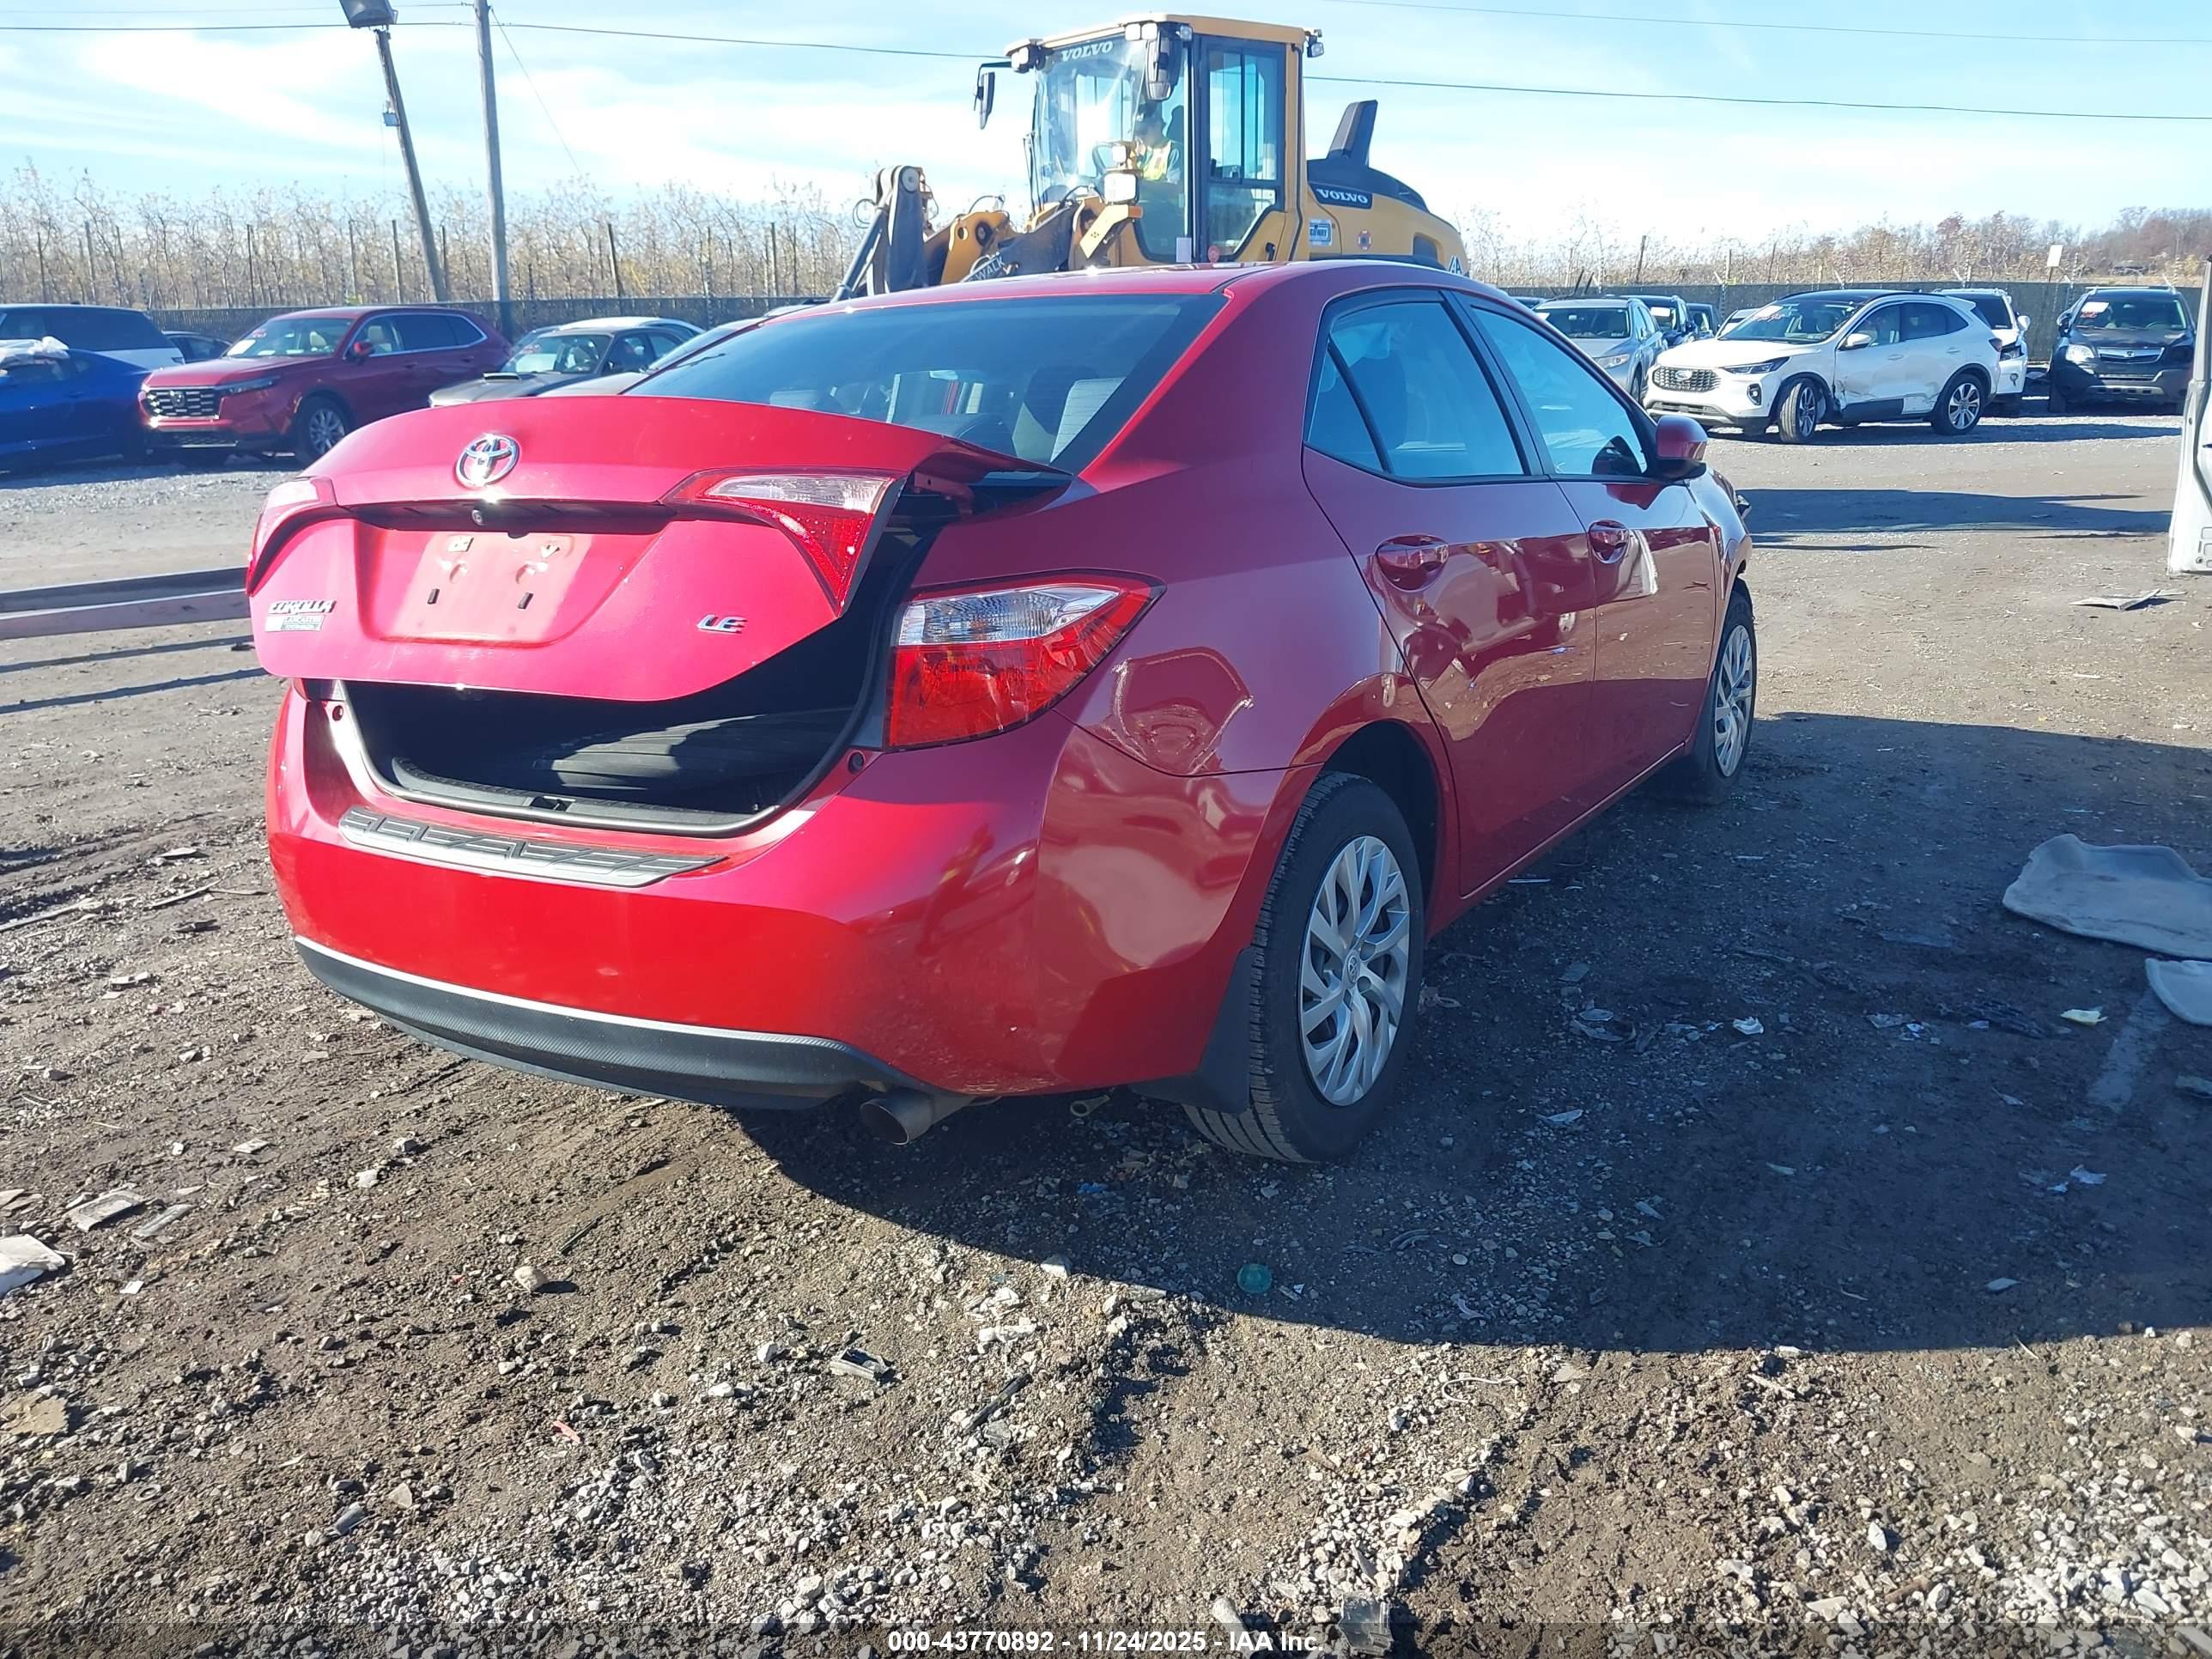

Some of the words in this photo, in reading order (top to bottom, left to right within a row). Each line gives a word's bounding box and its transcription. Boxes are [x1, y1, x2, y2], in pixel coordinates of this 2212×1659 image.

[1060, 40, 1114, 62] VOLVO
[1316, 188, 1369, 204] VOLVO
[697, 614, 747, 633] LE
